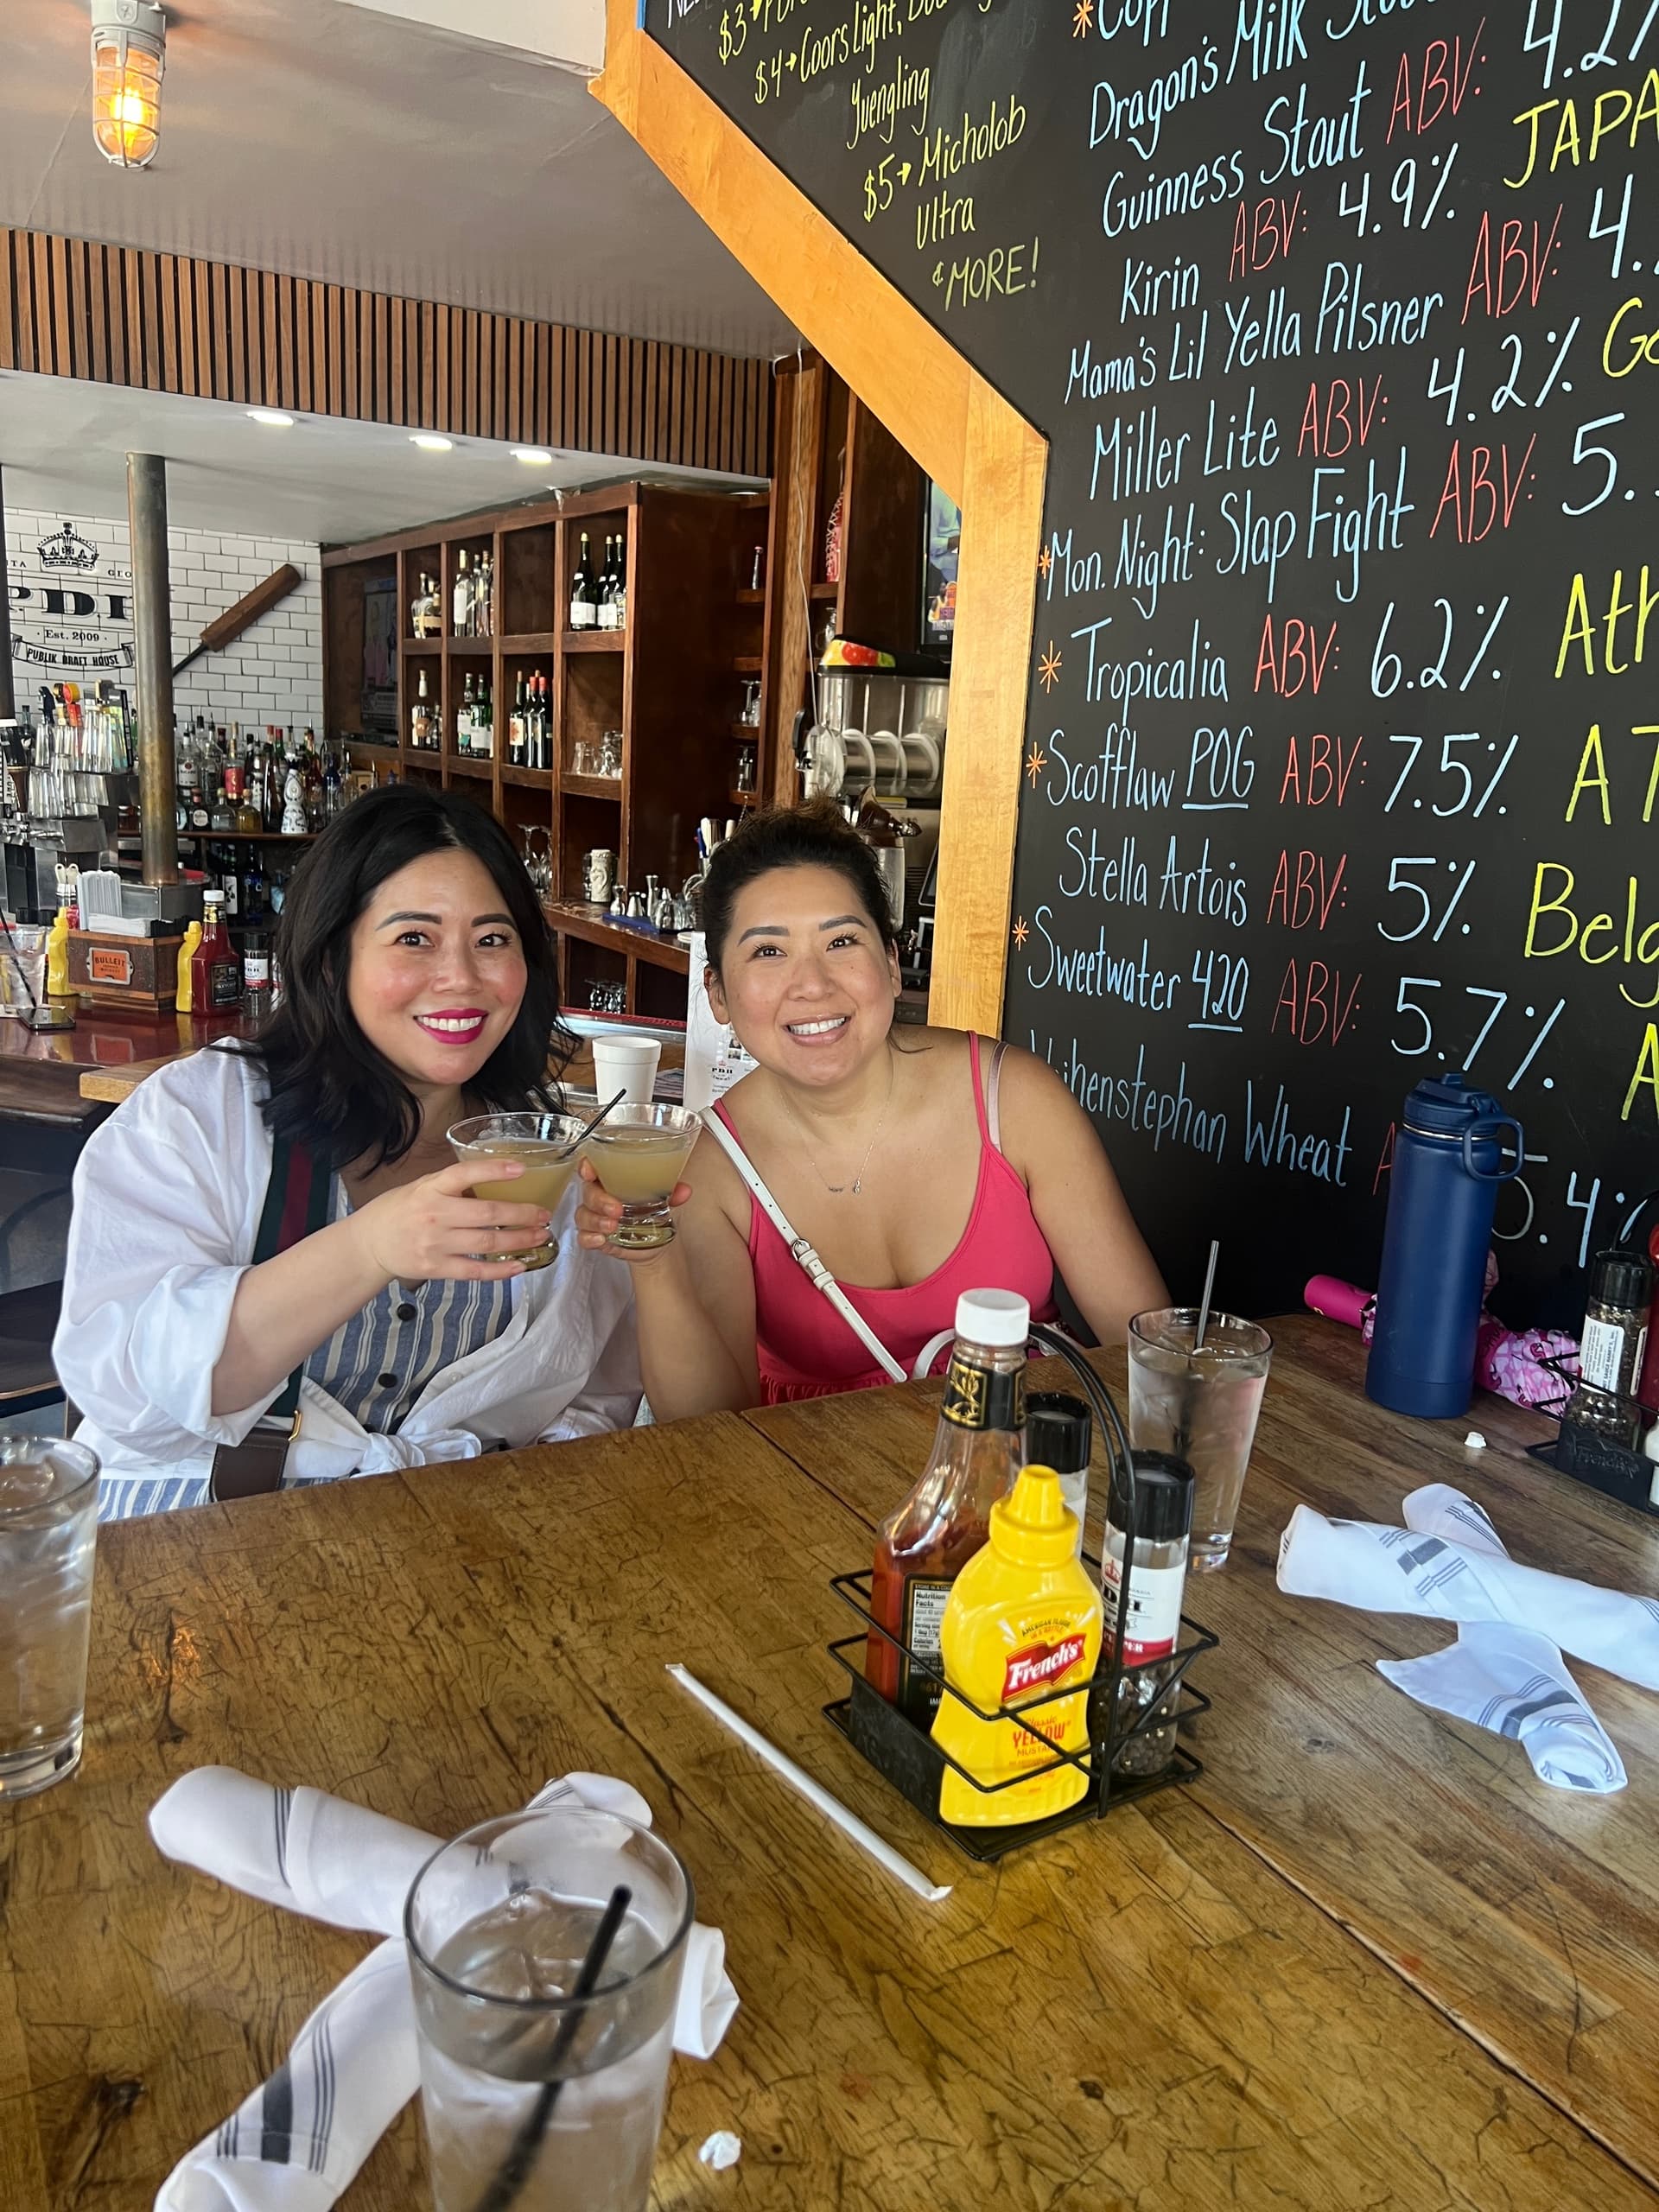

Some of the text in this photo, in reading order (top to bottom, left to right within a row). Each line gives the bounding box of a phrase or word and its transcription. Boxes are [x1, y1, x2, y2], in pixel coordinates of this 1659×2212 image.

[719, 3, 747, 65] $3
[755, 49, 782, 104] $4
[800, 23, 849, 82] Coors
[853, 0, 902, 73] Light,
[1090, 0, 1307, 160] Dragon's Milk
[846, 55, 930, 149] Yuengling
[1101, 150, 1244, 238] Guinness
[1260, 61, 1370, 185] Stout
[1386, 17, 1486, 144] ABV:
[864, 95, 1026, 222] $5 Micholob
[916, 189, 976, 250] Ultra
[1120, 143, 1459, 324] Kirin ABV: 4.9%
[1064, 174, 1659, 404] Mama's Lil Yella Pilsner ABV: 4.
[1090, 316, 1580, 501] Miller Lite ABV: 4.2%
[1046, 529, 1107, 601] Mon.
[1115, 502, 1205, 620] Night:
[1215, 490, 1297, 604] Slap
[1306, 445, 1415, 604] Fight
[1429, 433, 1537, 543] ABV:
[27, 648, 57, 664] PUBLIK
[92, 654, 119, 666] HOUSE
[46, 629, 99, 641] Est. 2009
[1071, 596, 1510, 725] Tropicalia ABV: 6.2%
[1046, 723, 1518, 819] Scofflaw POG ABV: 7.5%
[1057, 825, 1476, 942] Stella Artois ABV: 5%
[95, 957, 125, 967] BULLEIT
[1027, 906, 1566, 1091] Sweetwater 420 ABV: 5.7%
[1244, 1079, 1352, 1187] Wheat
[916, 1591, 946, 1599] Nutrition
[1008, 1642, 1078, 1690] French's
